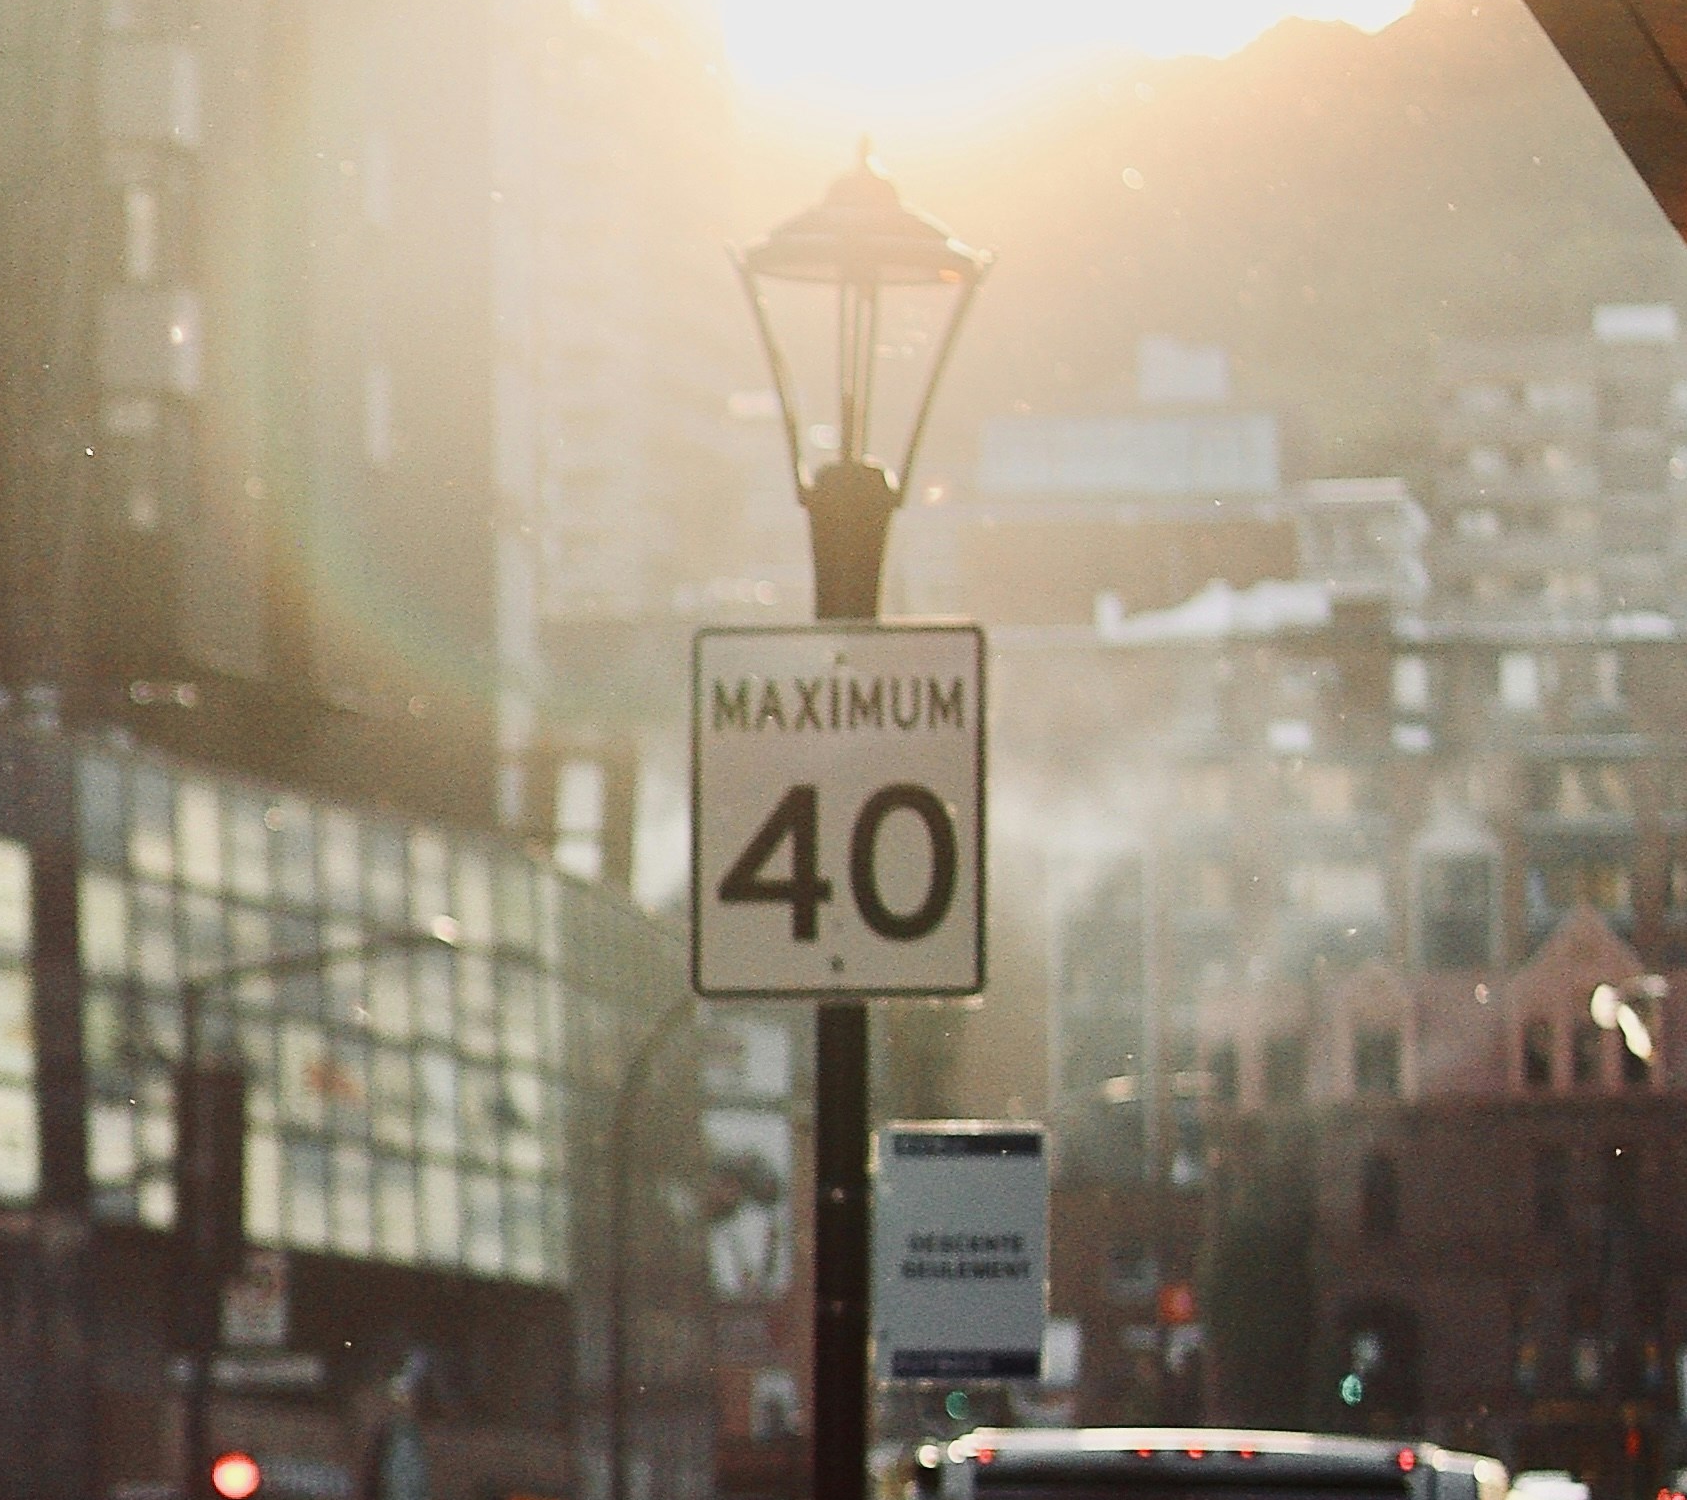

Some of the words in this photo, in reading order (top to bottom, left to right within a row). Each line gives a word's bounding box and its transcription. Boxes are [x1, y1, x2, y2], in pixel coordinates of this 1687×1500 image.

[714, 676, 965, 731] MAXIMUM
[718, 782, 958, 941] 40
[901, 1260, 1031, 1279] SEULEMENT
